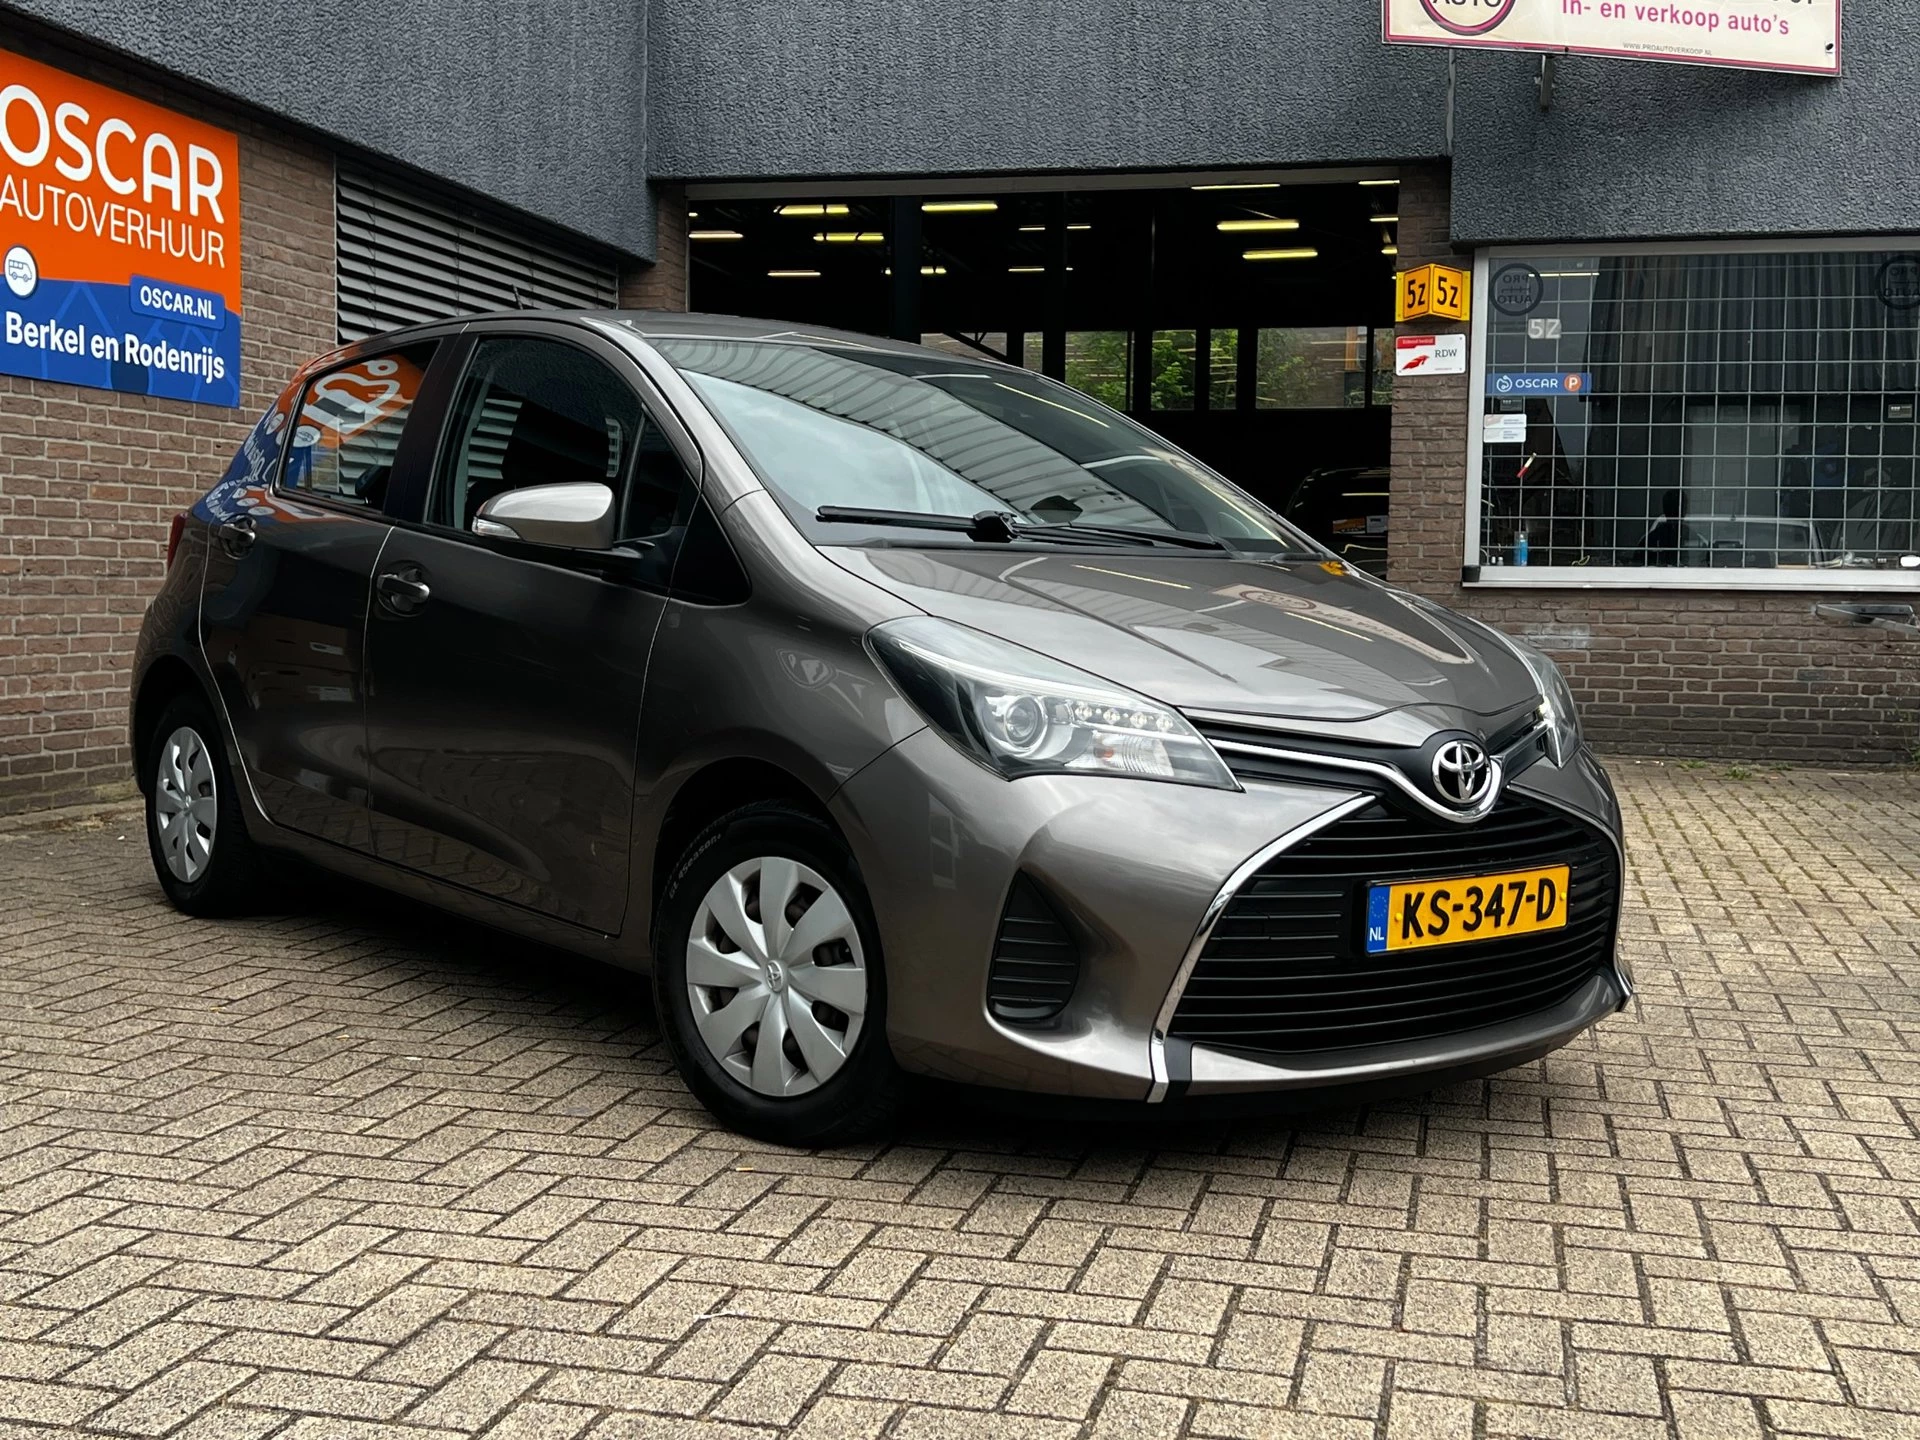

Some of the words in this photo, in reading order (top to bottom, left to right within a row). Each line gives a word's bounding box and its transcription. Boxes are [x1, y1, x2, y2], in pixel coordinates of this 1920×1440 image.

[1600, 2, 1625, 19] en
[1635, 4, 1719, 32] verkoop
[1728, 14, 1789, 35] auto's
[0, 85, 224, 224] OSCAR
[0, 174, 225, 268] AUTOVERHUUR
[140, 285, 216, 320] OSCAR.NL
[6, 310, 85, 355] Berkel
[91, 333, 119, 361] en
[125, 333, 225, 383] Rodenrijs
[1434, 349, 1457, 358] RDW
[1515, 378, 1558, 388] OSCAR
[1401, 878, 1556, 940] KS-347-D
[1369, 927, 1385, 941] NL
